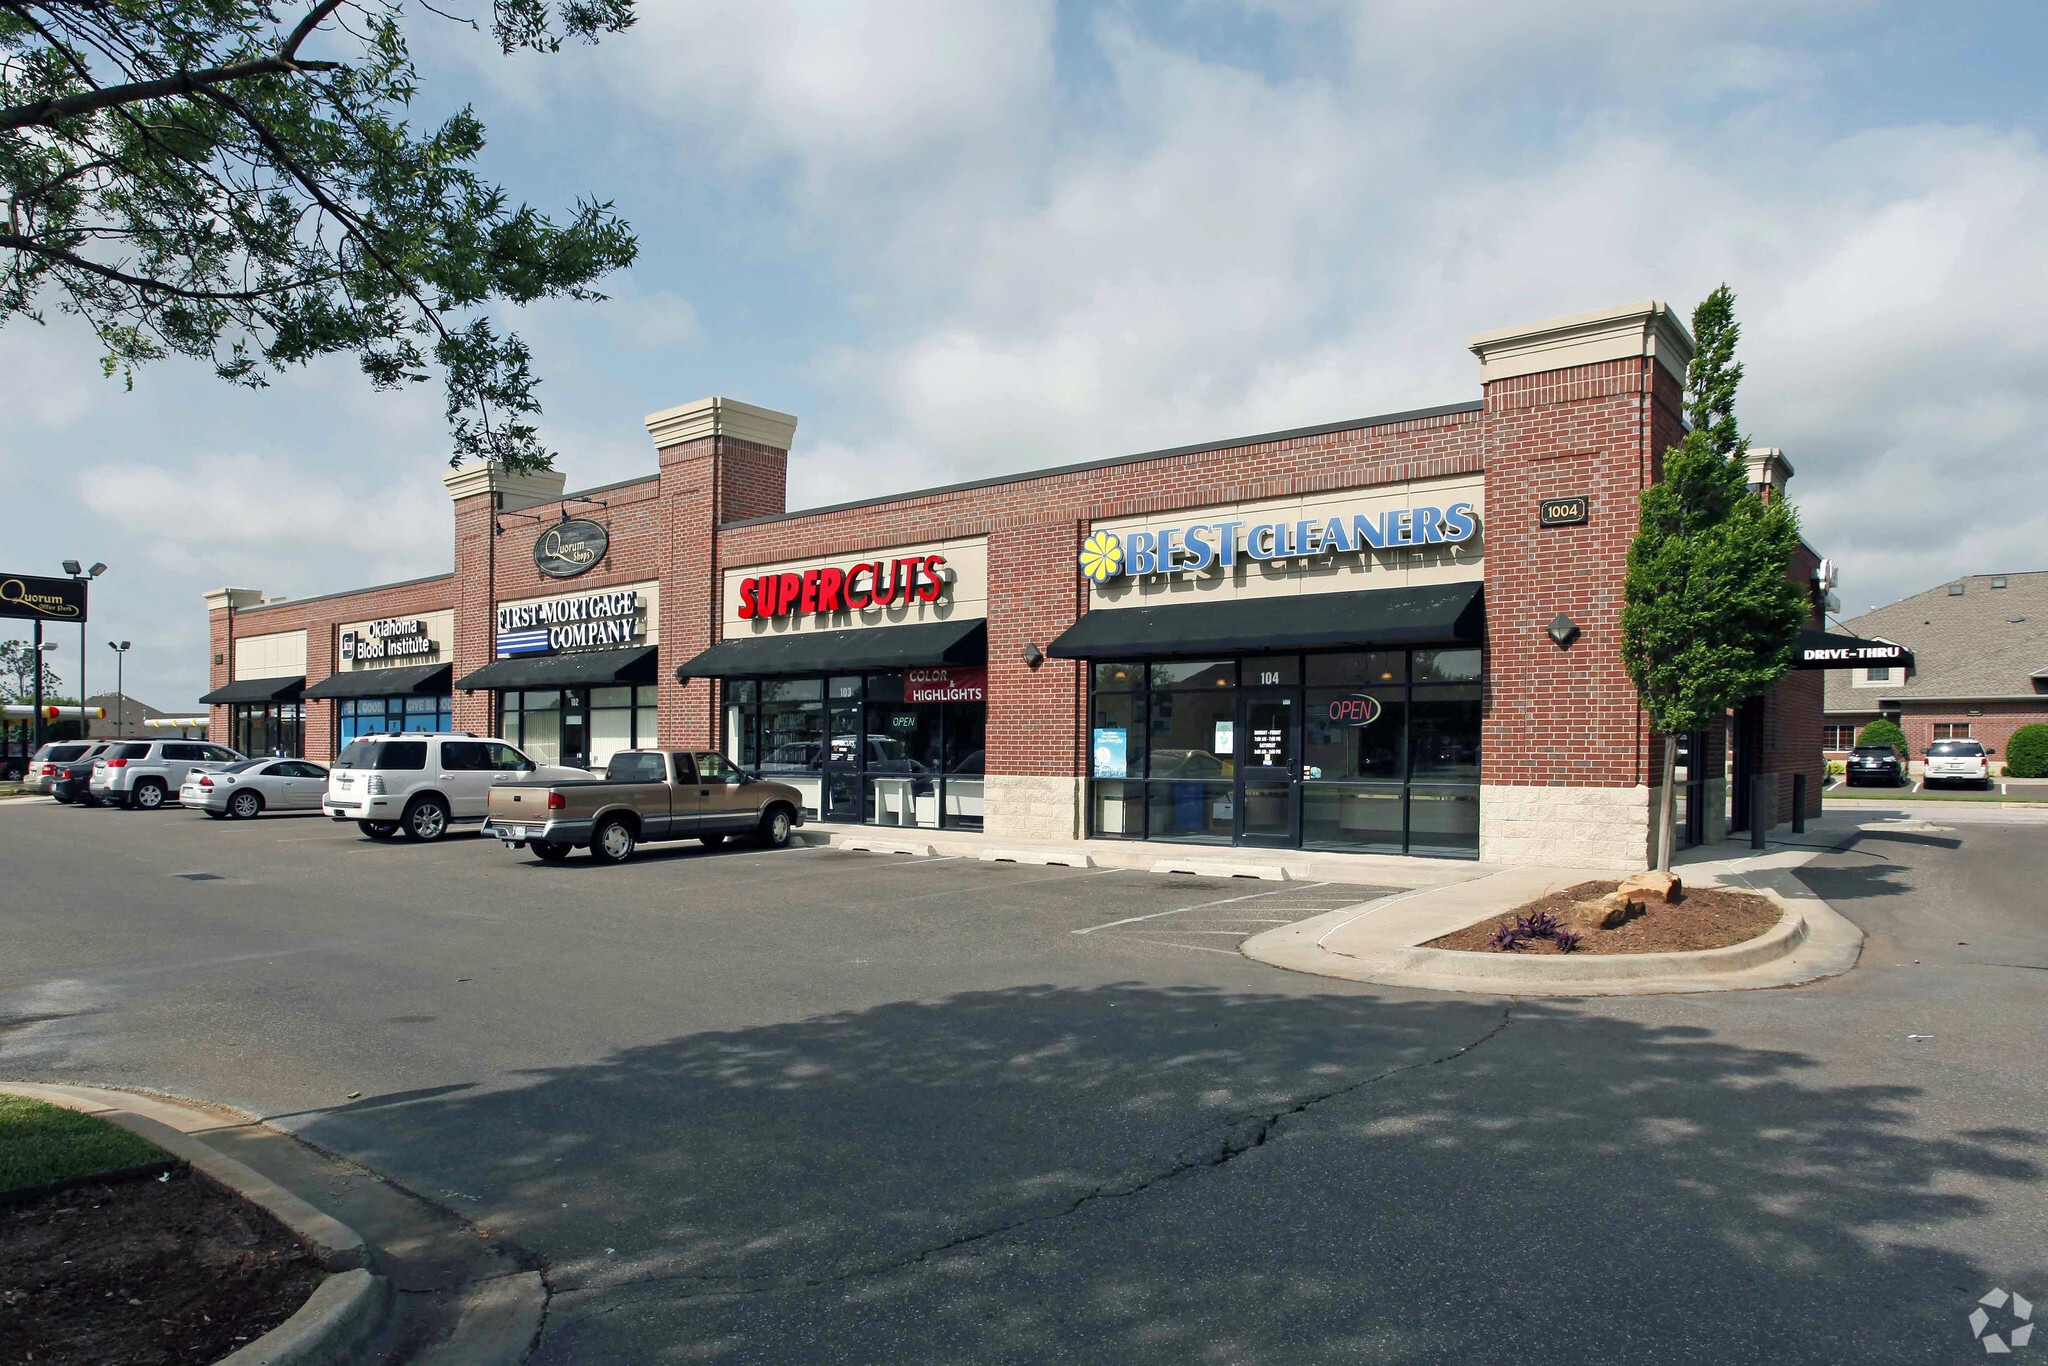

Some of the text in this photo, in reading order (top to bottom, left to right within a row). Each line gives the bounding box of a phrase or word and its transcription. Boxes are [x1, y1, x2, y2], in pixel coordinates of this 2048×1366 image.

[1547, 504, 1578, 518] 1004
[545, 530, 585, 559] Quorum
[1124, 502, 1476, 577] BEST CLEANERS
[573, 551, 591, 562] Shops
[0, 579, 63, 605] Quorum
[738, 555, 946, 619] SUPERCUTS
[497, 590, 635, 630] FIRST MORTGAGE
[368, 619, 417, 638] Oklahoma
[551, 618, 633, 650] COMPANY
[357, 636, 430, 659] Blood Institute
[1803, 646, 1900, 660] DRIVE-THRU
[909, 670, 947, 682] COLOR
[1260, 671, 1279, 685] 104
[949, 680, 956, 688] &
[840, 687, 852, 698] 103
[913, 688, 982, 701] HIGHLIGHTS
[406, 697, 452, 711] GIVE BLOD
[1329, 700, 1372, 720] OPEN
[892, 716, 915, 727] OPEN
